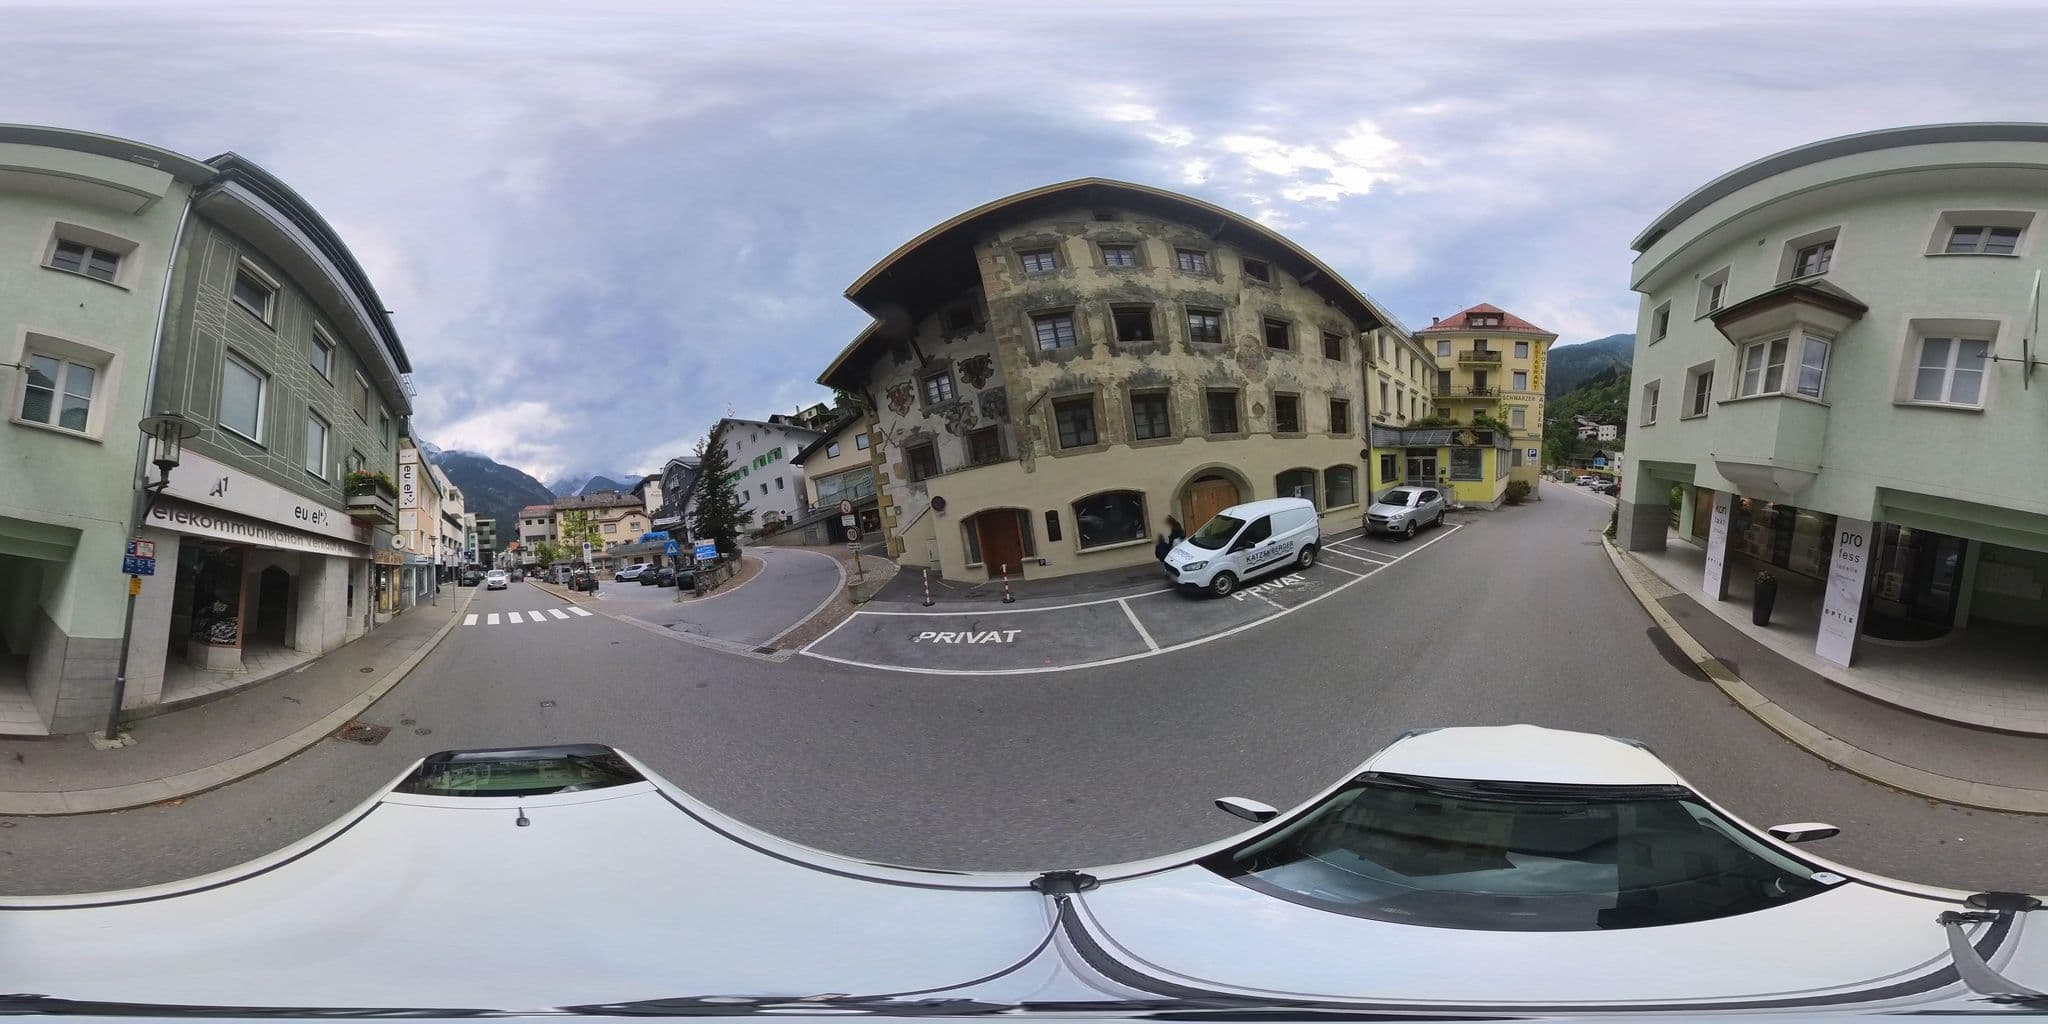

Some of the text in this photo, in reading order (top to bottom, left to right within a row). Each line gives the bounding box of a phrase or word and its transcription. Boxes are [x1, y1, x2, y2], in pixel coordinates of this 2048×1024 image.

[1502, 394, 1536, 402] SCHWARZER
[150, 503, 303, 546] elekommunikation
[1840, 531, 1862, 547] pro
[1838, 548, 1860, 563] fess
[1231, 572, 1306, 601] PRIVAT
[913, 629, 1022, 643] PRIVAT
